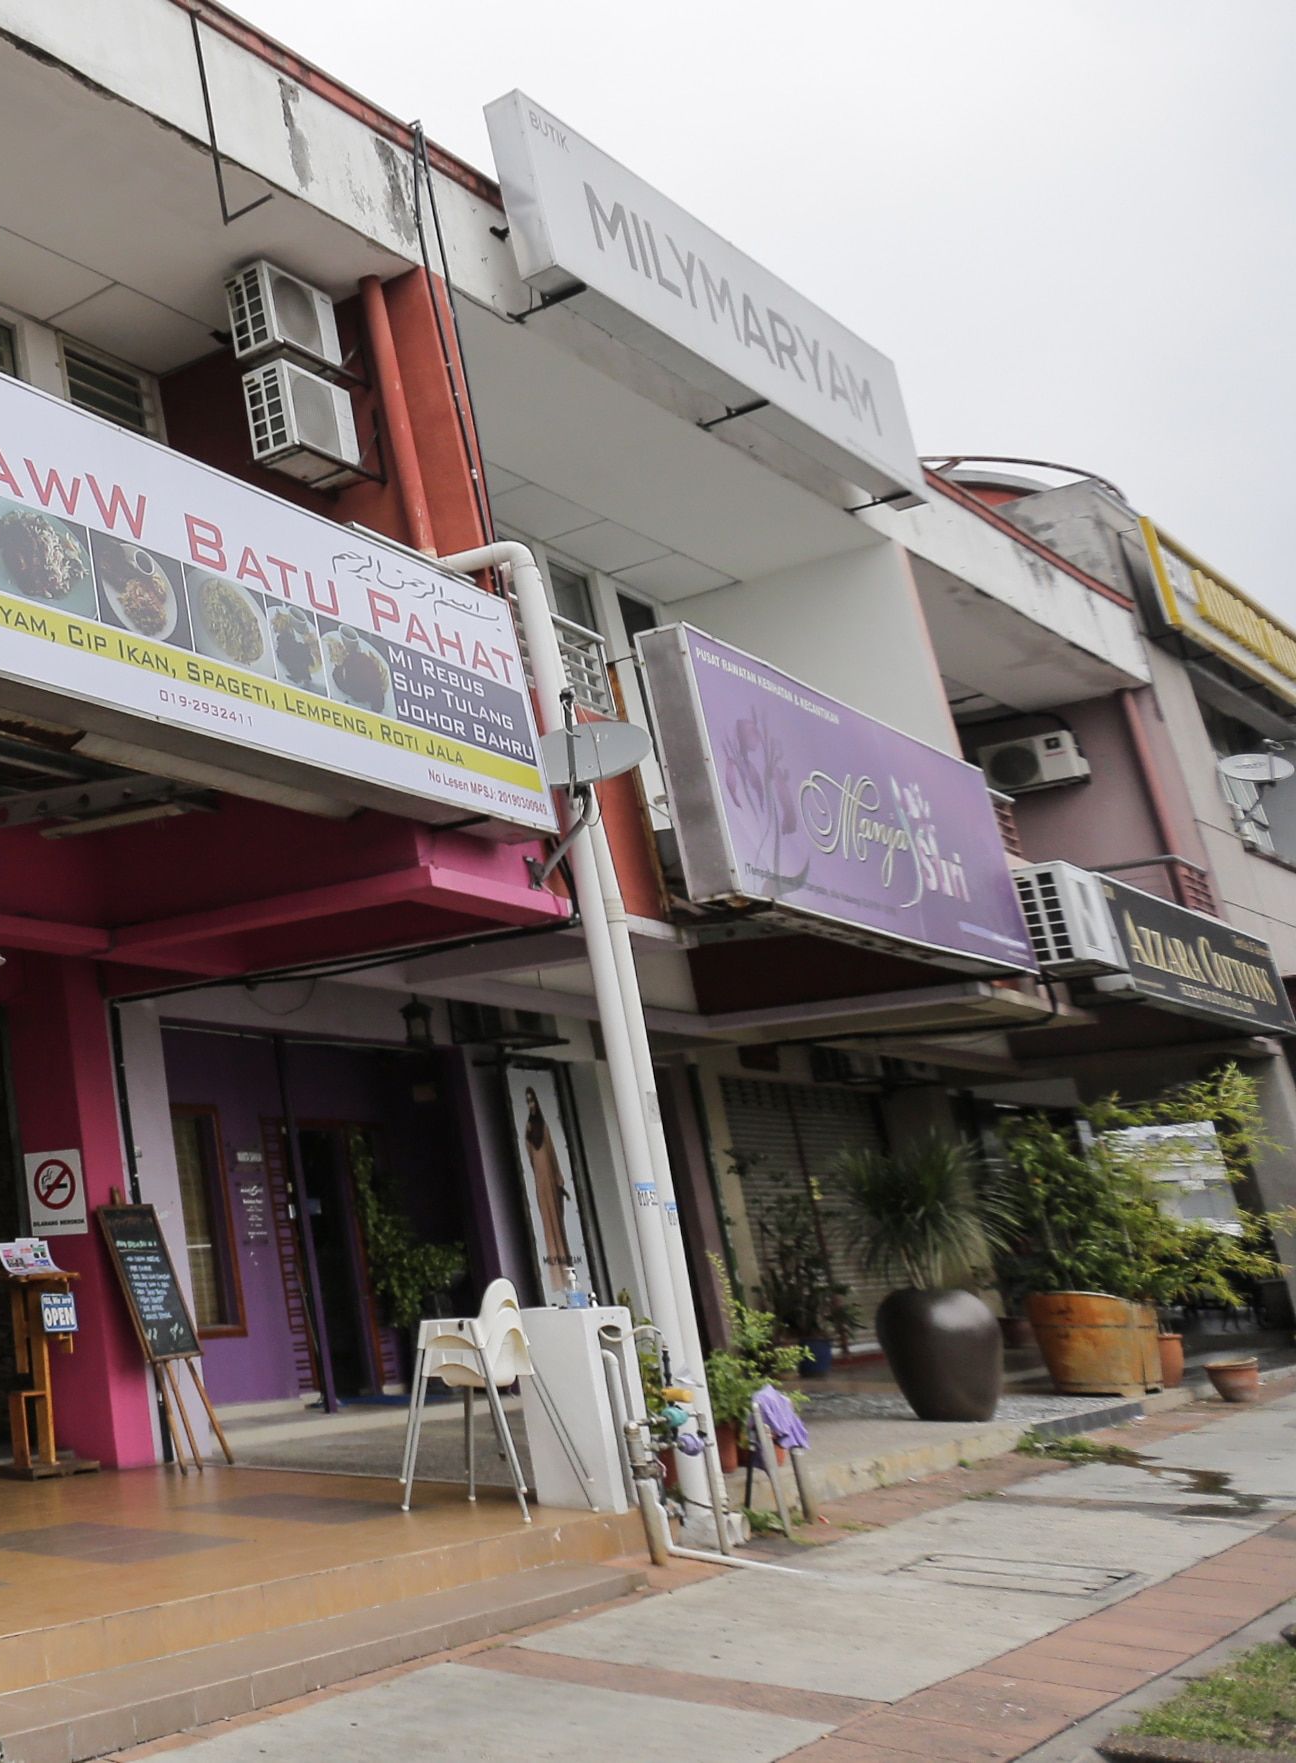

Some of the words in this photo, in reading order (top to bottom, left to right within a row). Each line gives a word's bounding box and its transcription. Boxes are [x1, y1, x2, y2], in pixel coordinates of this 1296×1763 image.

[528, 111, 571, 154] BUTIK
[582, 179, 883, 437] MILYMARYAM
[184, 512, 340, 616] BATU
[366, 588, 514, 685] PAHAT
[388, 645, 413, 670] MI
[420, 657, 485, 698] REBUS
[695, 646, 720, 669] PUSAT
[67, 623, 107, 652] CIP
[118, 639, 177, 679] IKAN,
[186, 660, 276, 710] SPAGETI,
[283, 692, 373, 741] LEMPENG,
[380, 723, 419, 751] ROTI
[425, 739, 465, 766] JALA
[159, 688, 253, 727] 019-2932411
[392, 670, 435, 700] SUP
[441, 688, 514, 731] TULANG
[397, 698, 466, 737] JOHOR
[472, 722, 534, 761] BAHRU
[427, 768, 442, 784] No
[443, 773, 469, 792] Lesen
[470, 780, 497, 801] MPSJ:
[1123, 909, 1208, 984] AZZARA
[44, 1306, 75, 1328] OPEN
